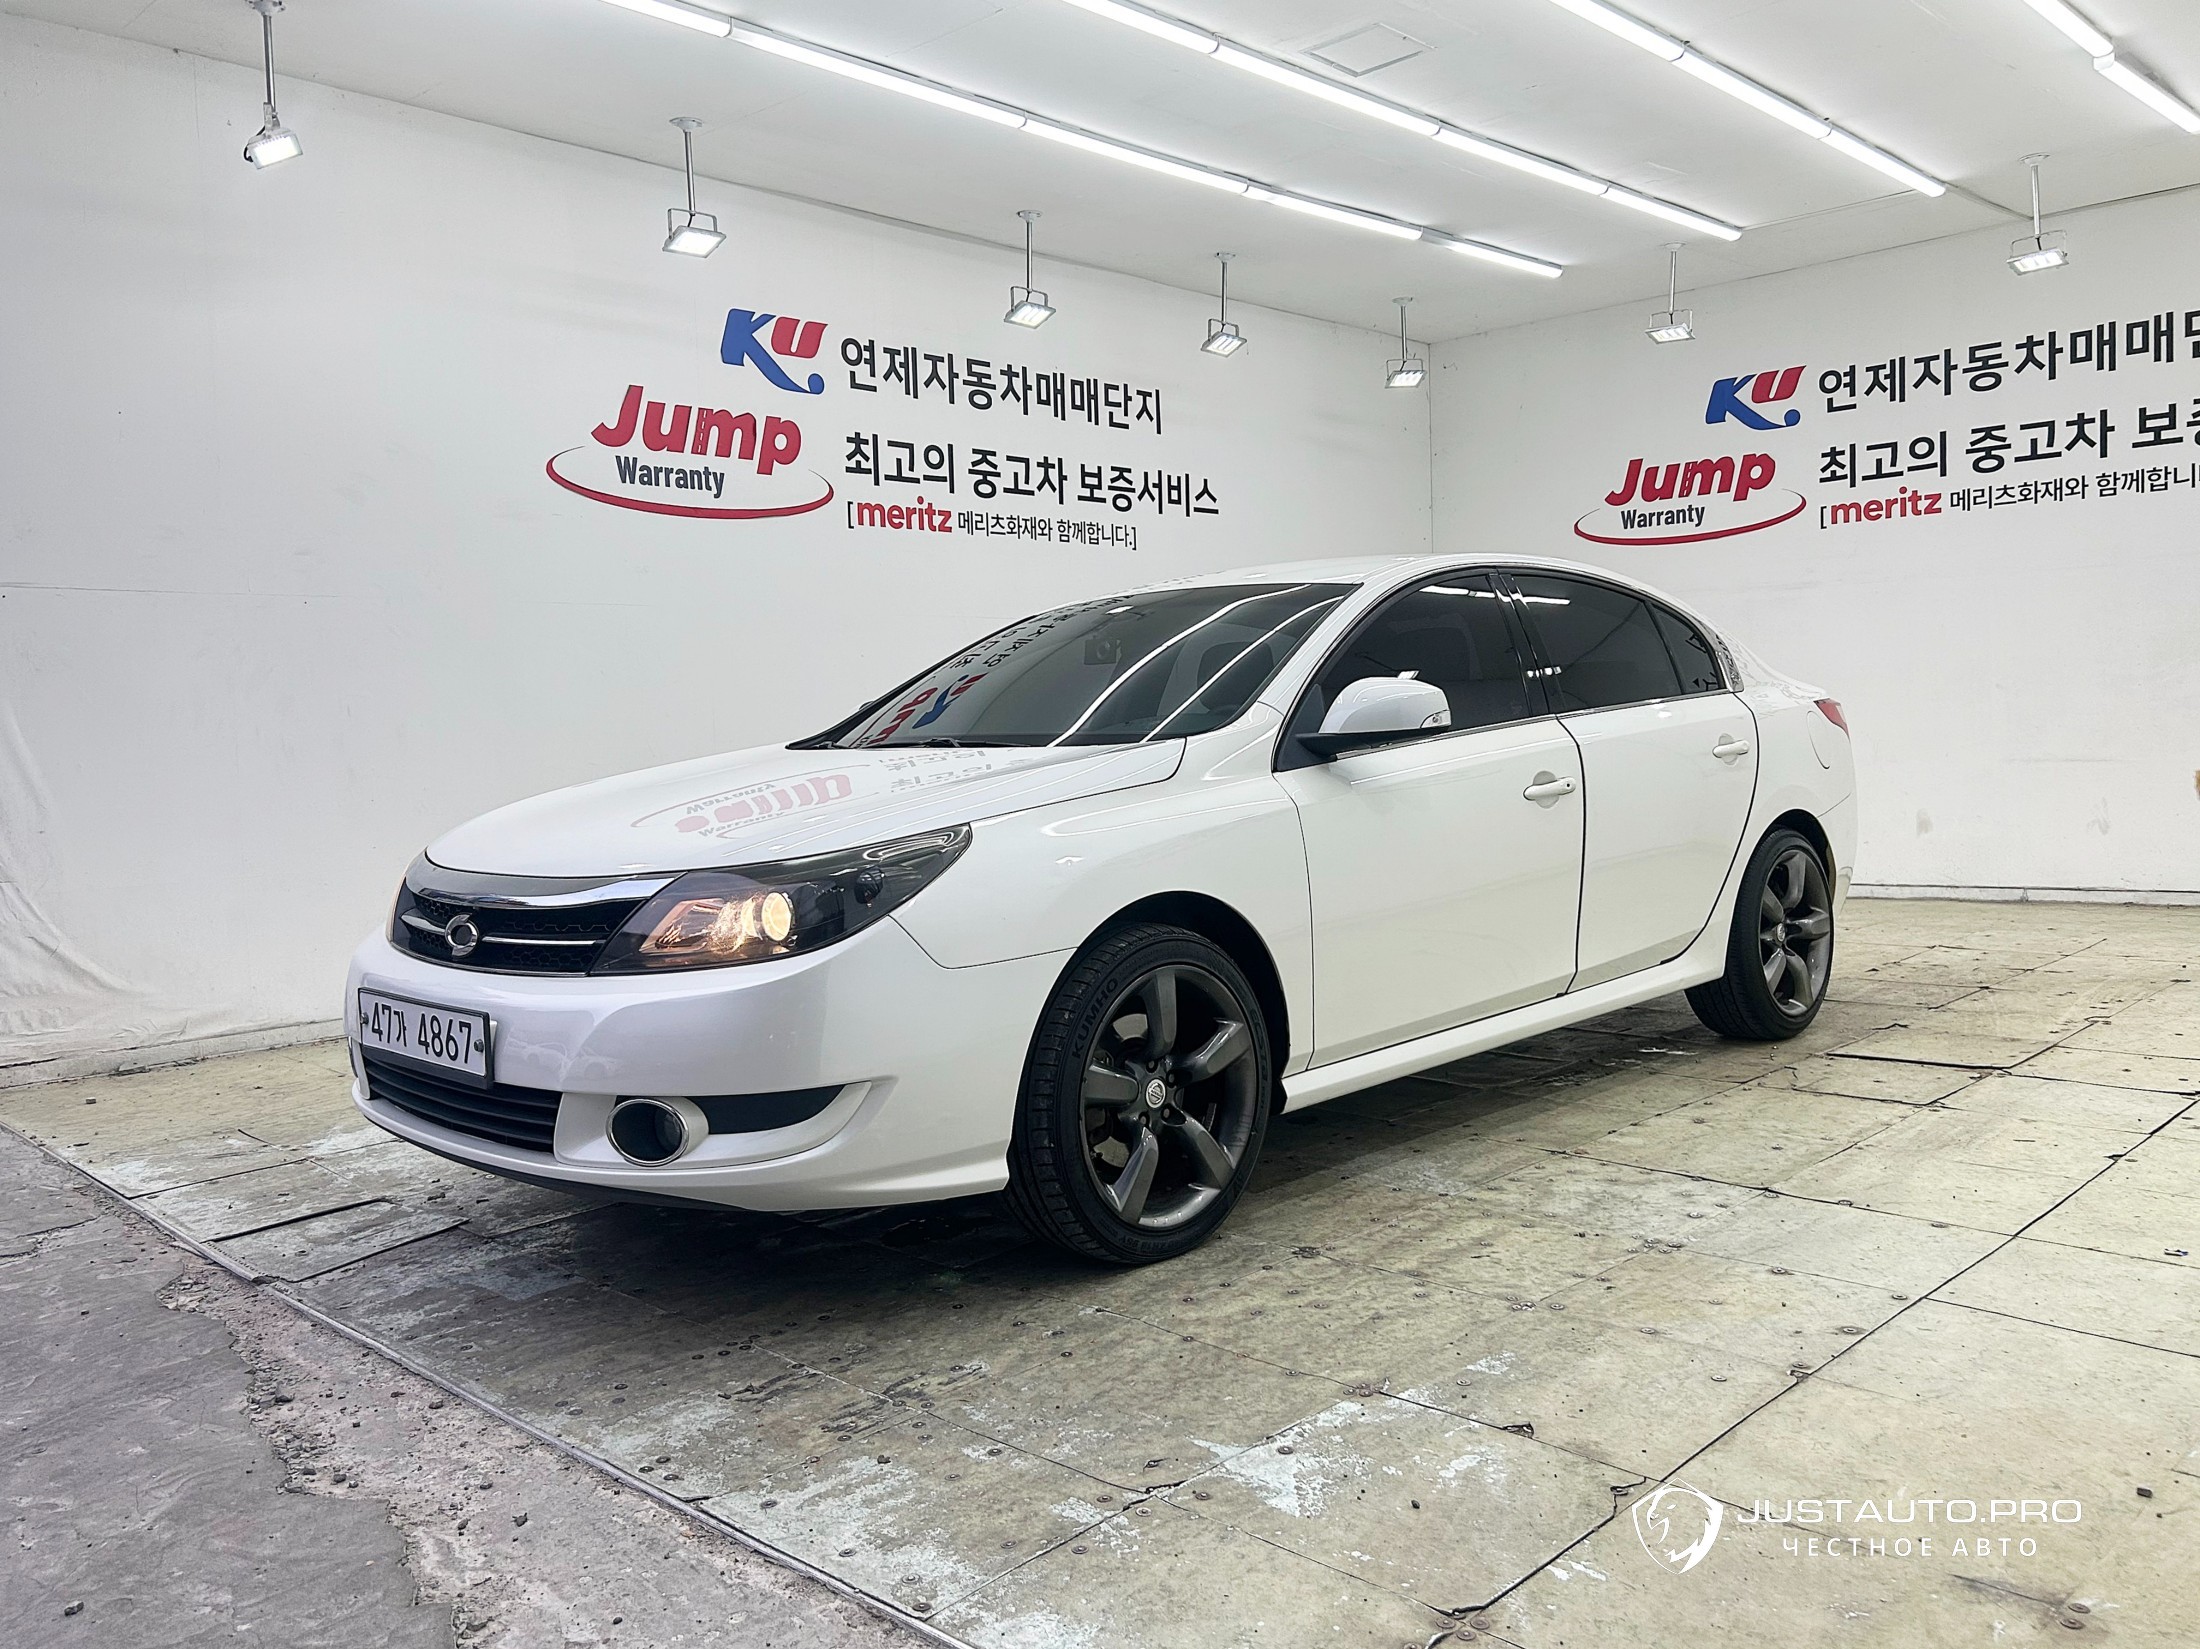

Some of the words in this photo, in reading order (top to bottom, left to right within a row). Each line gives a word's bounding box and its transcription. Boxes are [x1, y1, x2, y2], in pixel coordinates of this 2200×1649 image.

[841, 338, 1161, 434] 연제자동차매매단지
[591, 385, 801, 475] Jump
[1819, 431, 1947, 488] 최고의
[1966, 409, 2115, 473] 중고차
[615, 456, 724, 498] Warranty
[846, 432, 954, 494] 최고의
[968, 448, 1067, 505] 중고차
[1078, 464, 1219, 517] 보증서비스
[1605, 453, 1775, 506] Jump
[1950, 475, 2089, 511] 메리츠화재와
[2096, 463, 2200, 497] 함께합니
[958, 511, 1053, 541] 메리츠화재와
[1621, 505, 1705, 529] Warranty
[371, 1001, 407, 1048] 47가
[417, 1012, 472, 1065] 4867
[1071, 977, 1118, 1059] KUMHO
